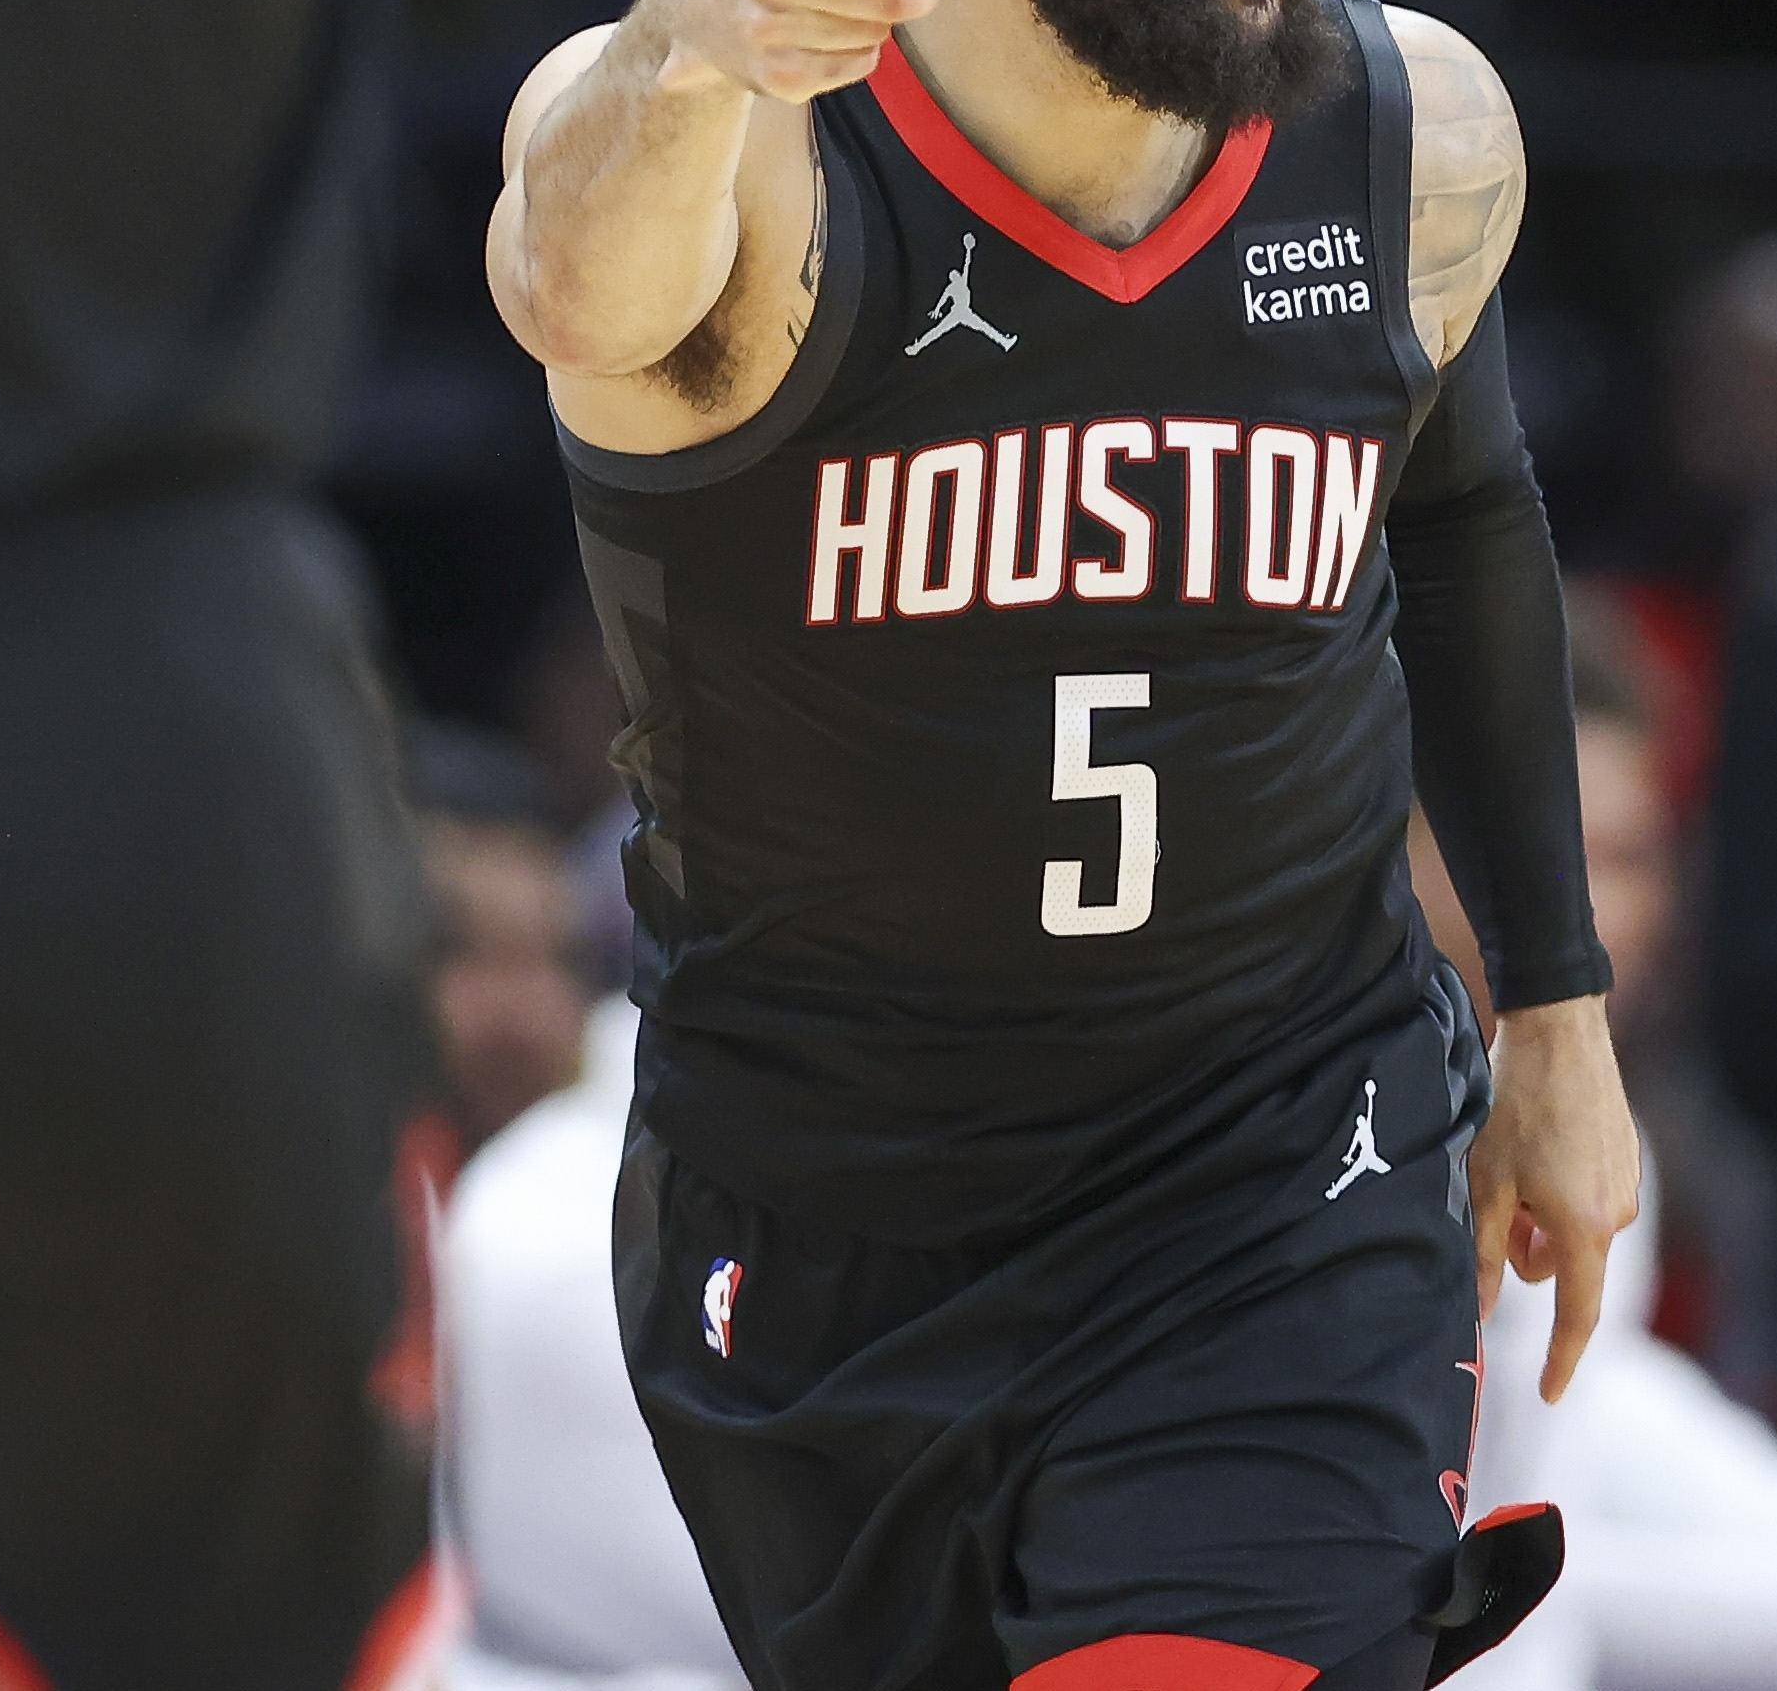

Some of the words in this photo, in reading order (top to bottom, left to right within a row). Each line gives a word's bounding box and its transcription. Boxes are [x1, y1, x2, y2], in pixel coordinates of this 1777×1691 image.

[1243, 280, 1371, 324] karma
[1245, 224, 1365, 276] credit
[805, 416, 1385, 626] HOUSTON
[1040, 673, 1159, 937] 5
